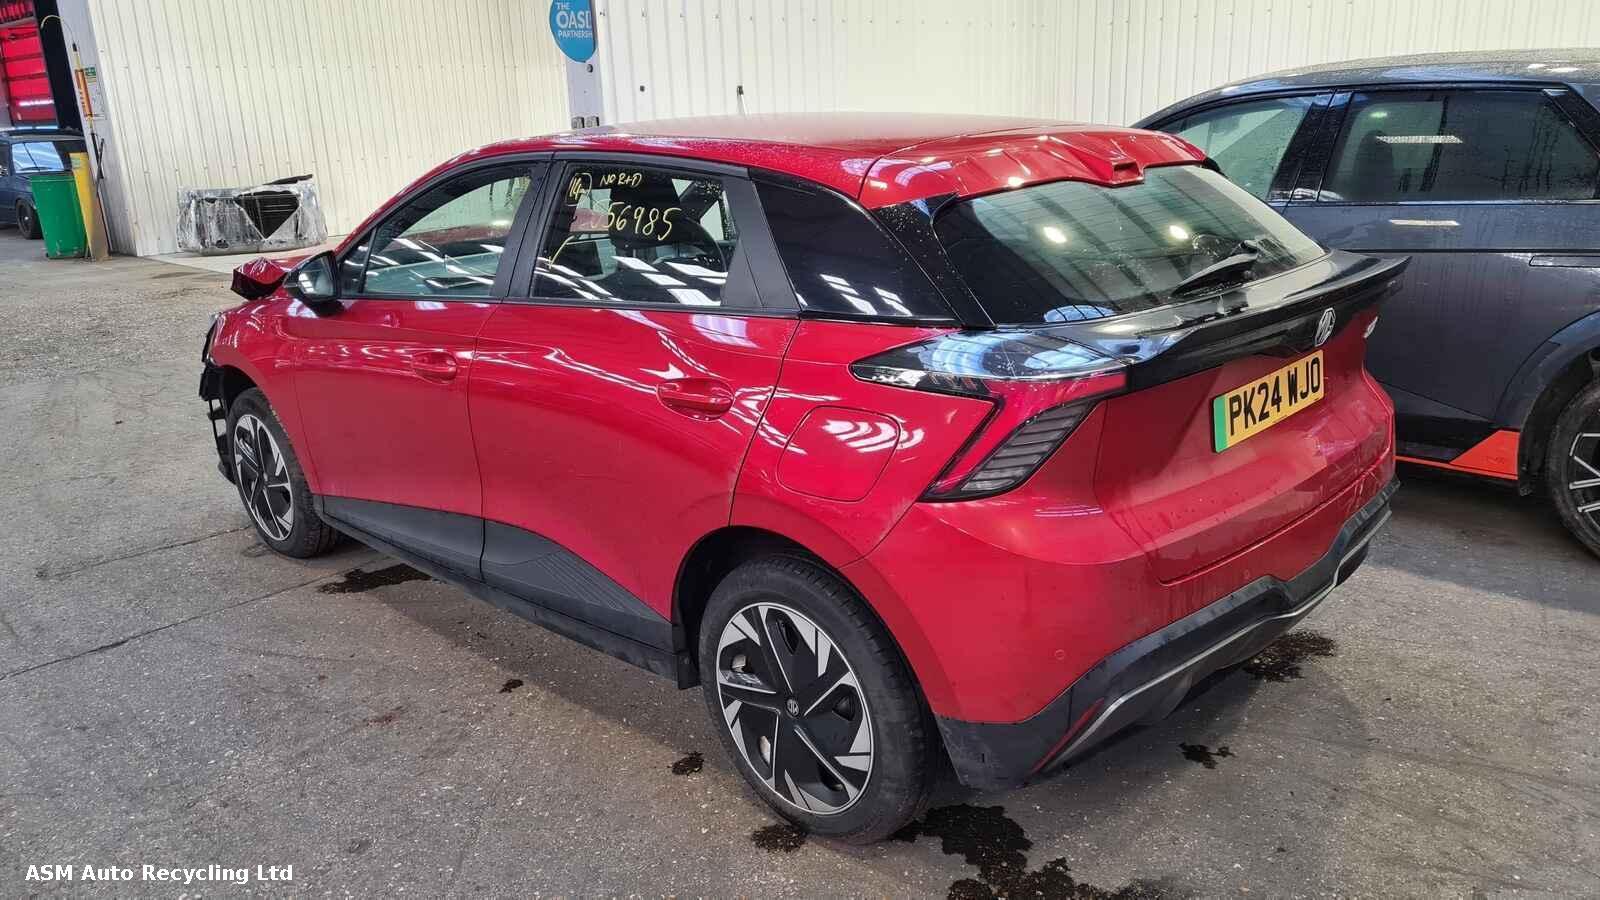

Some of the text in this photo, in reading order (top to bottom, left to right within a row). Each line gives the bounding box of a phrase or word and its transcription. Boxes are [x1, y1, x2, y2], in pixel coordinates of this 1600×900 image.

[555, 2, 570, 10] THE
[600, 174, 616, 187] NO
[1229, 357, 1321, 436] PK24 WJO
